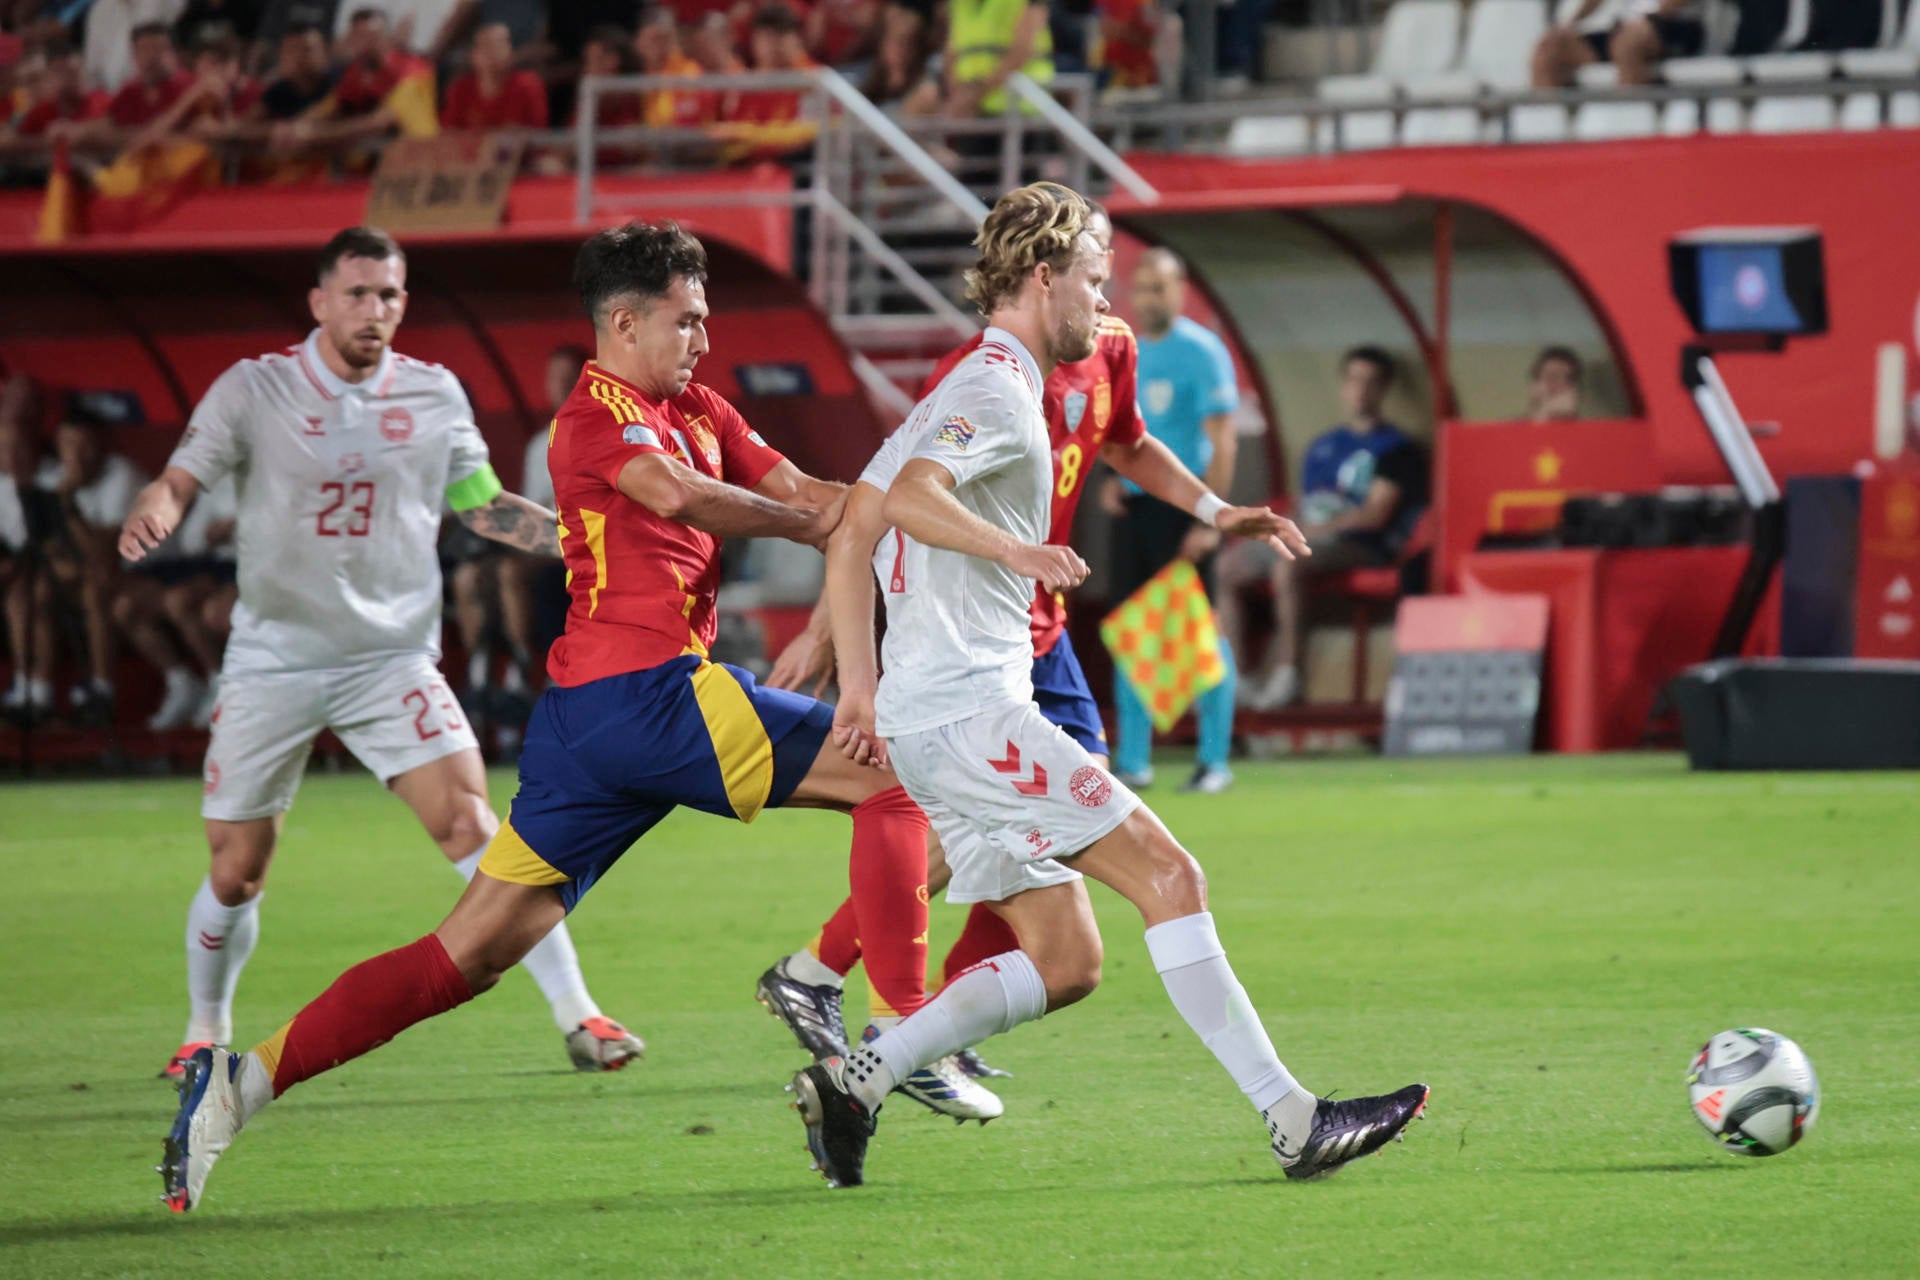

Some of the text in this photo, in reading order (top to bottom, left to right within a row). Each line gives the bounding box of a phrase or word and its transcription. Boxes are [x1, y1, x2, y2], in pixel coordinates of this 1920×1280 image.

[1058, 443, 1082, 498] 8
[317, 481, 374, 537] 23
[402, 684, 462, 741] 23
